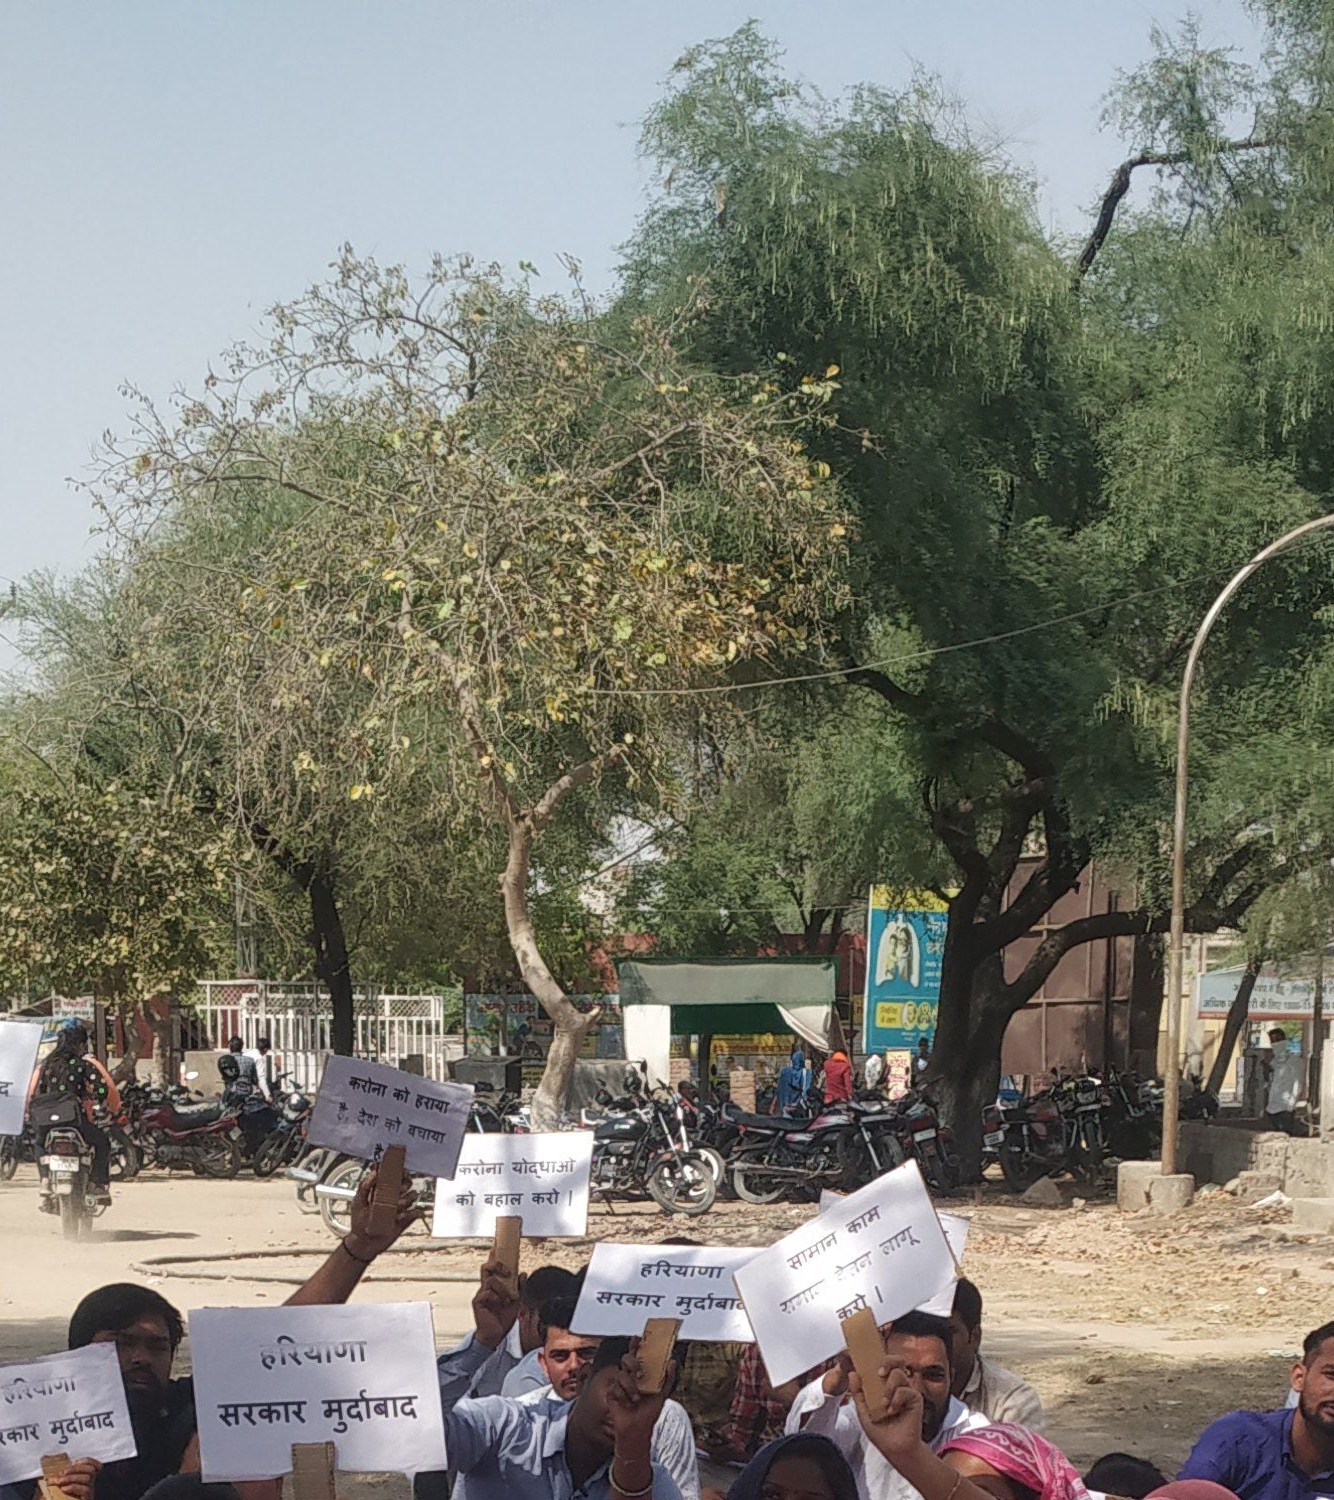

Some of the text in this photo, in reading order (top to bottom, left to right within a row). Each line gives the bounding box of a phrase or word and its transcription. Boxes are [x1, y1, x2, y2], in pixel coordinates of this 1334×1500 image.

[349, 1075, 450, 1114] करोना को हराया
[384, 1116, 401, 1134] को
[408, 1124, 446, 1144] बचाया
[459, 1159, 504, 1176] करोना
[455, 1190, 476, 1206] को
[484, 1193, 524, 1208] बहाल
[532, 1187, 560, 1205] करो
[786, 1205, 881, 1270] सामान काम
[879, 1225, 921, 1256] लागू
[640, 1261, 725, 1279] हरियाणा
[596, 1290, 666, 1310] सरकार
[835, 1293, 868, 1320] करो
[259, 1335, 367, 1370] हरियाणा
[217, 1389, 418, 1434] सरकार मुर्दाबाद
[49, 1410, 115, 1444] मुर्दाबाद
